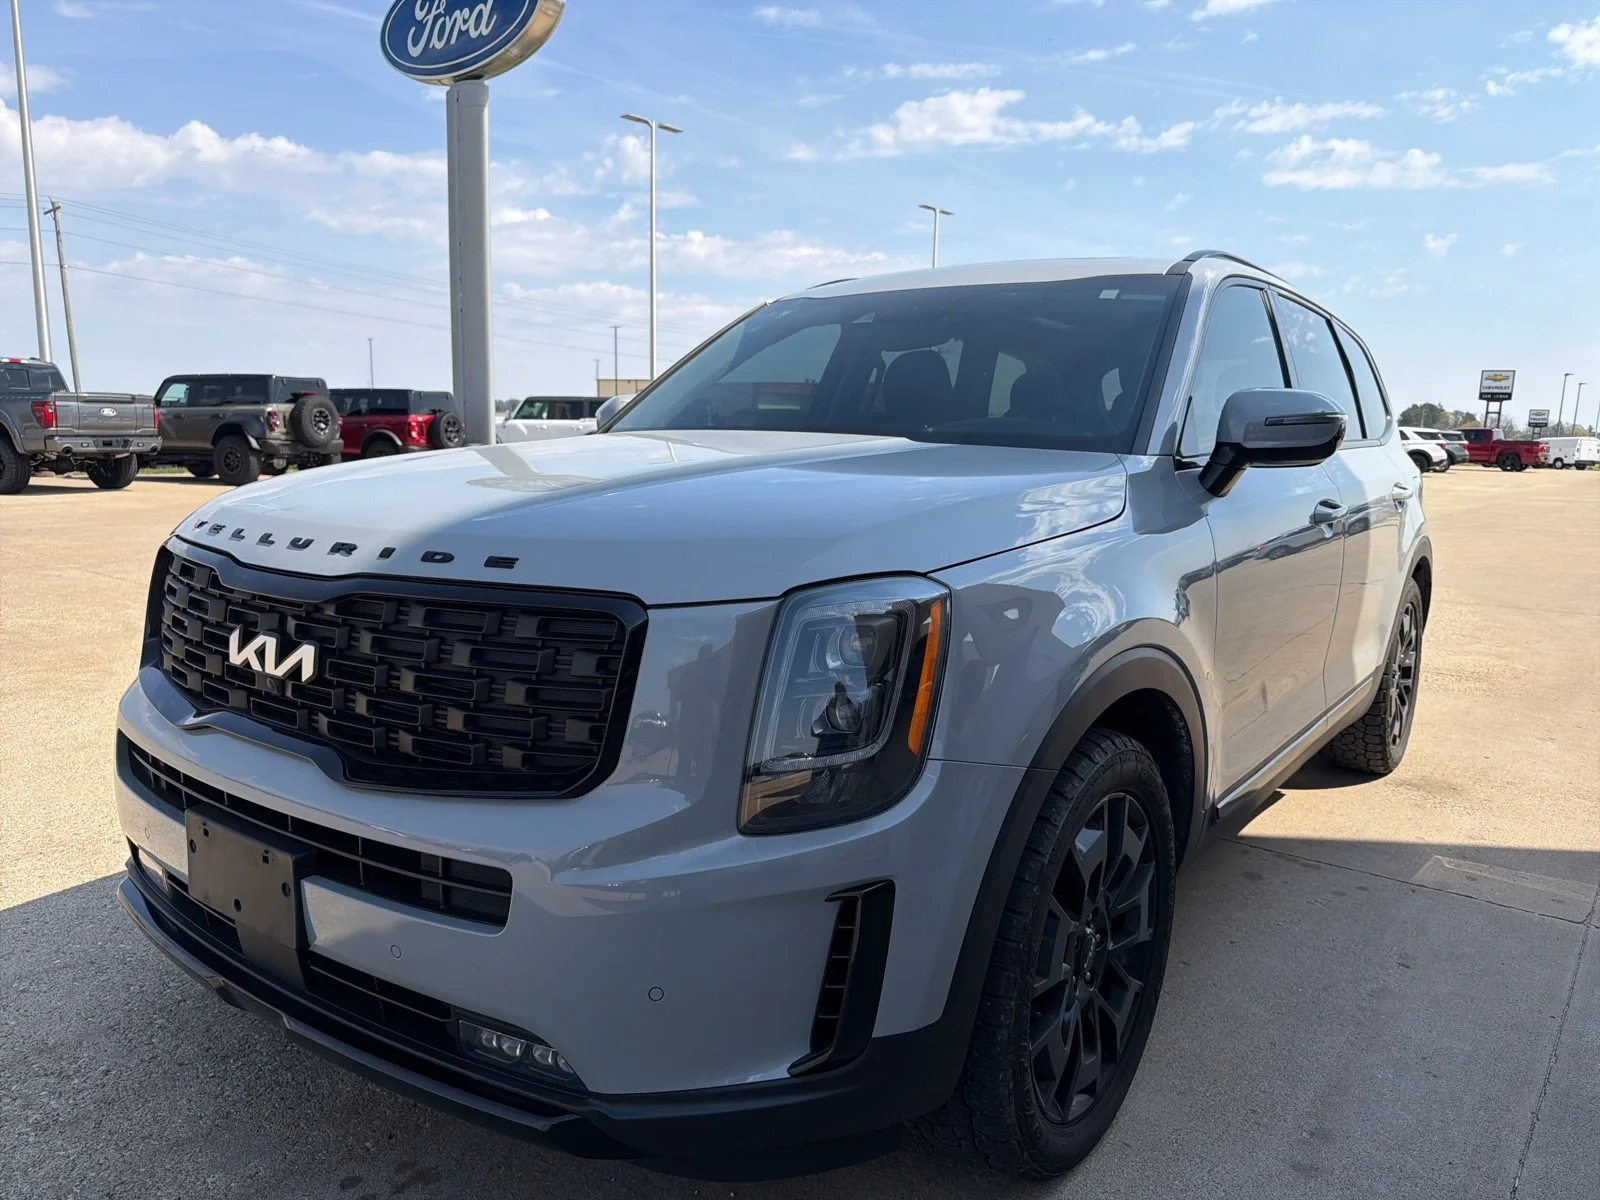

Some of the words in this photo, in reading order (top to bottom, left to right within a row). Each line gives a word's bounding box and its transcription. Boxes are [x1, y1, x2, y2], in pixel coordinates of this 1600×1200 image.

[407, 0, 497, 58] Ford
[195, 518, 520, 570] TELLURIDE
[229, 624, 316, 683] KIA
